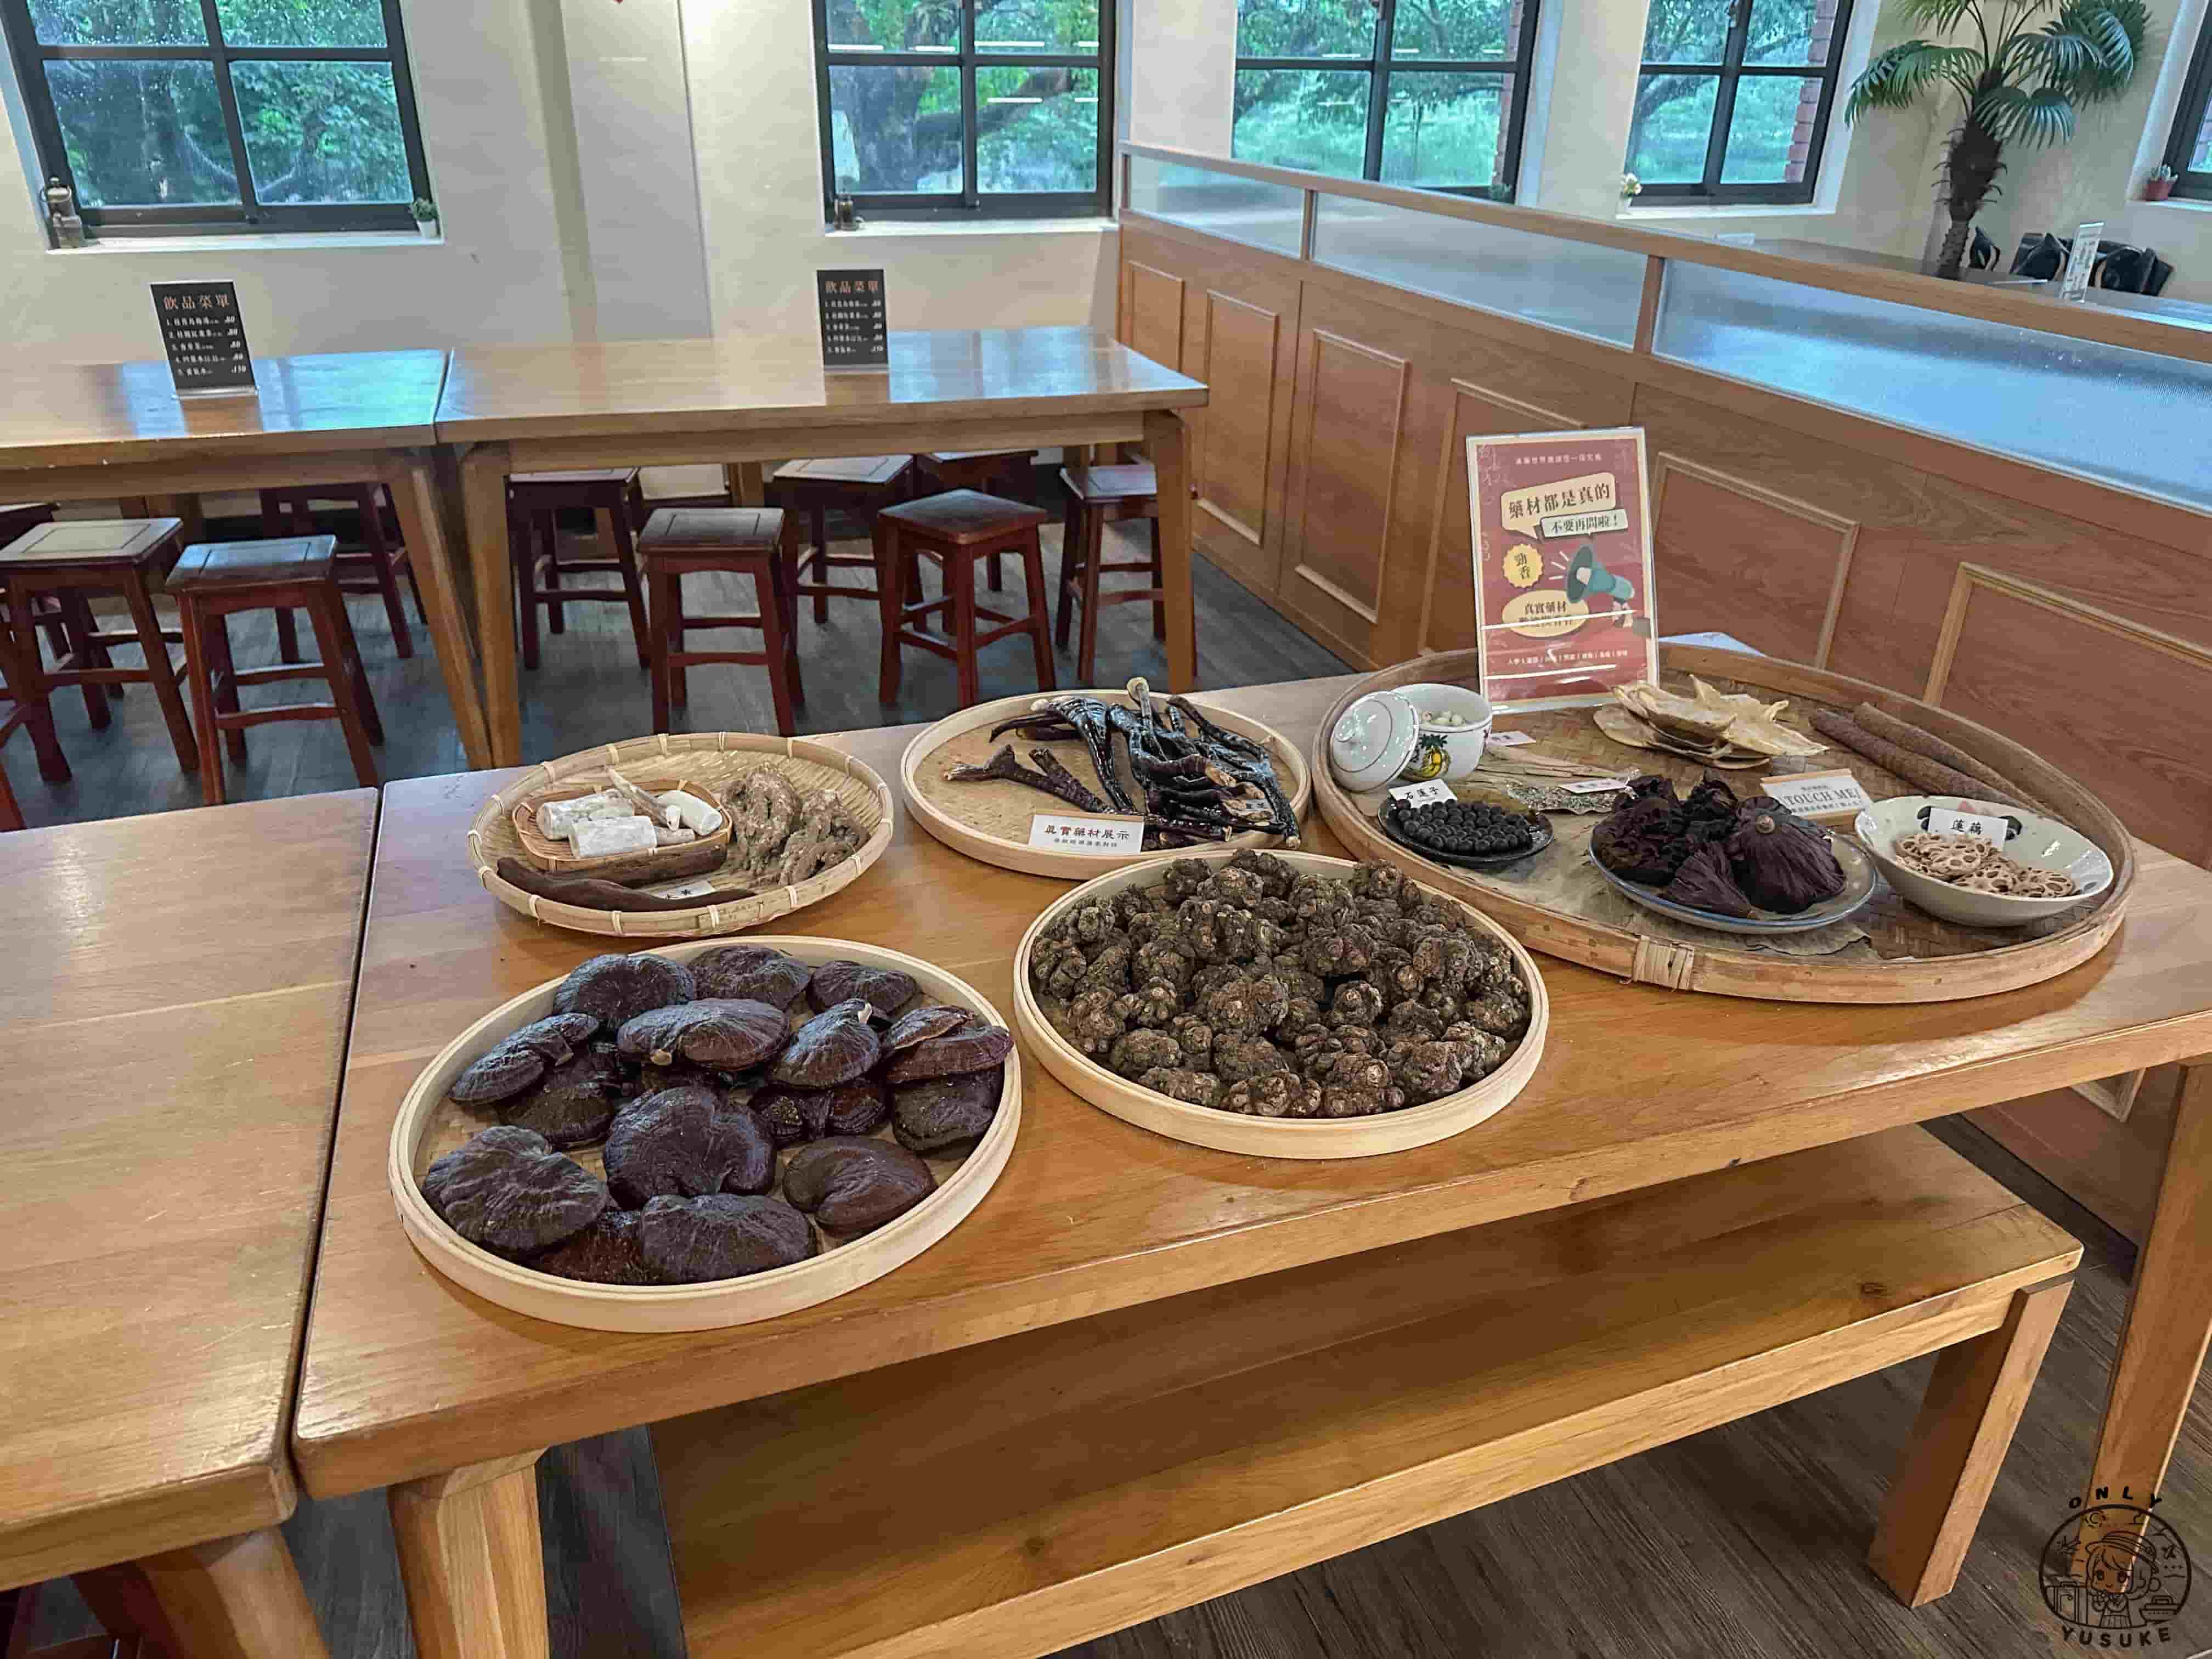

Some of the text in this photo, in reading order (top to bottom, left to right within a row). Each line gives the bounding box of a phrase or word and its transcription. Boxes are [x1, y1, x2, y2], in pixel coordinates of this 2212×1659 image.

[163, 294, 230, 311] 飲品菜單
[1509, 482, 1610, 518] 藥材都是真的
